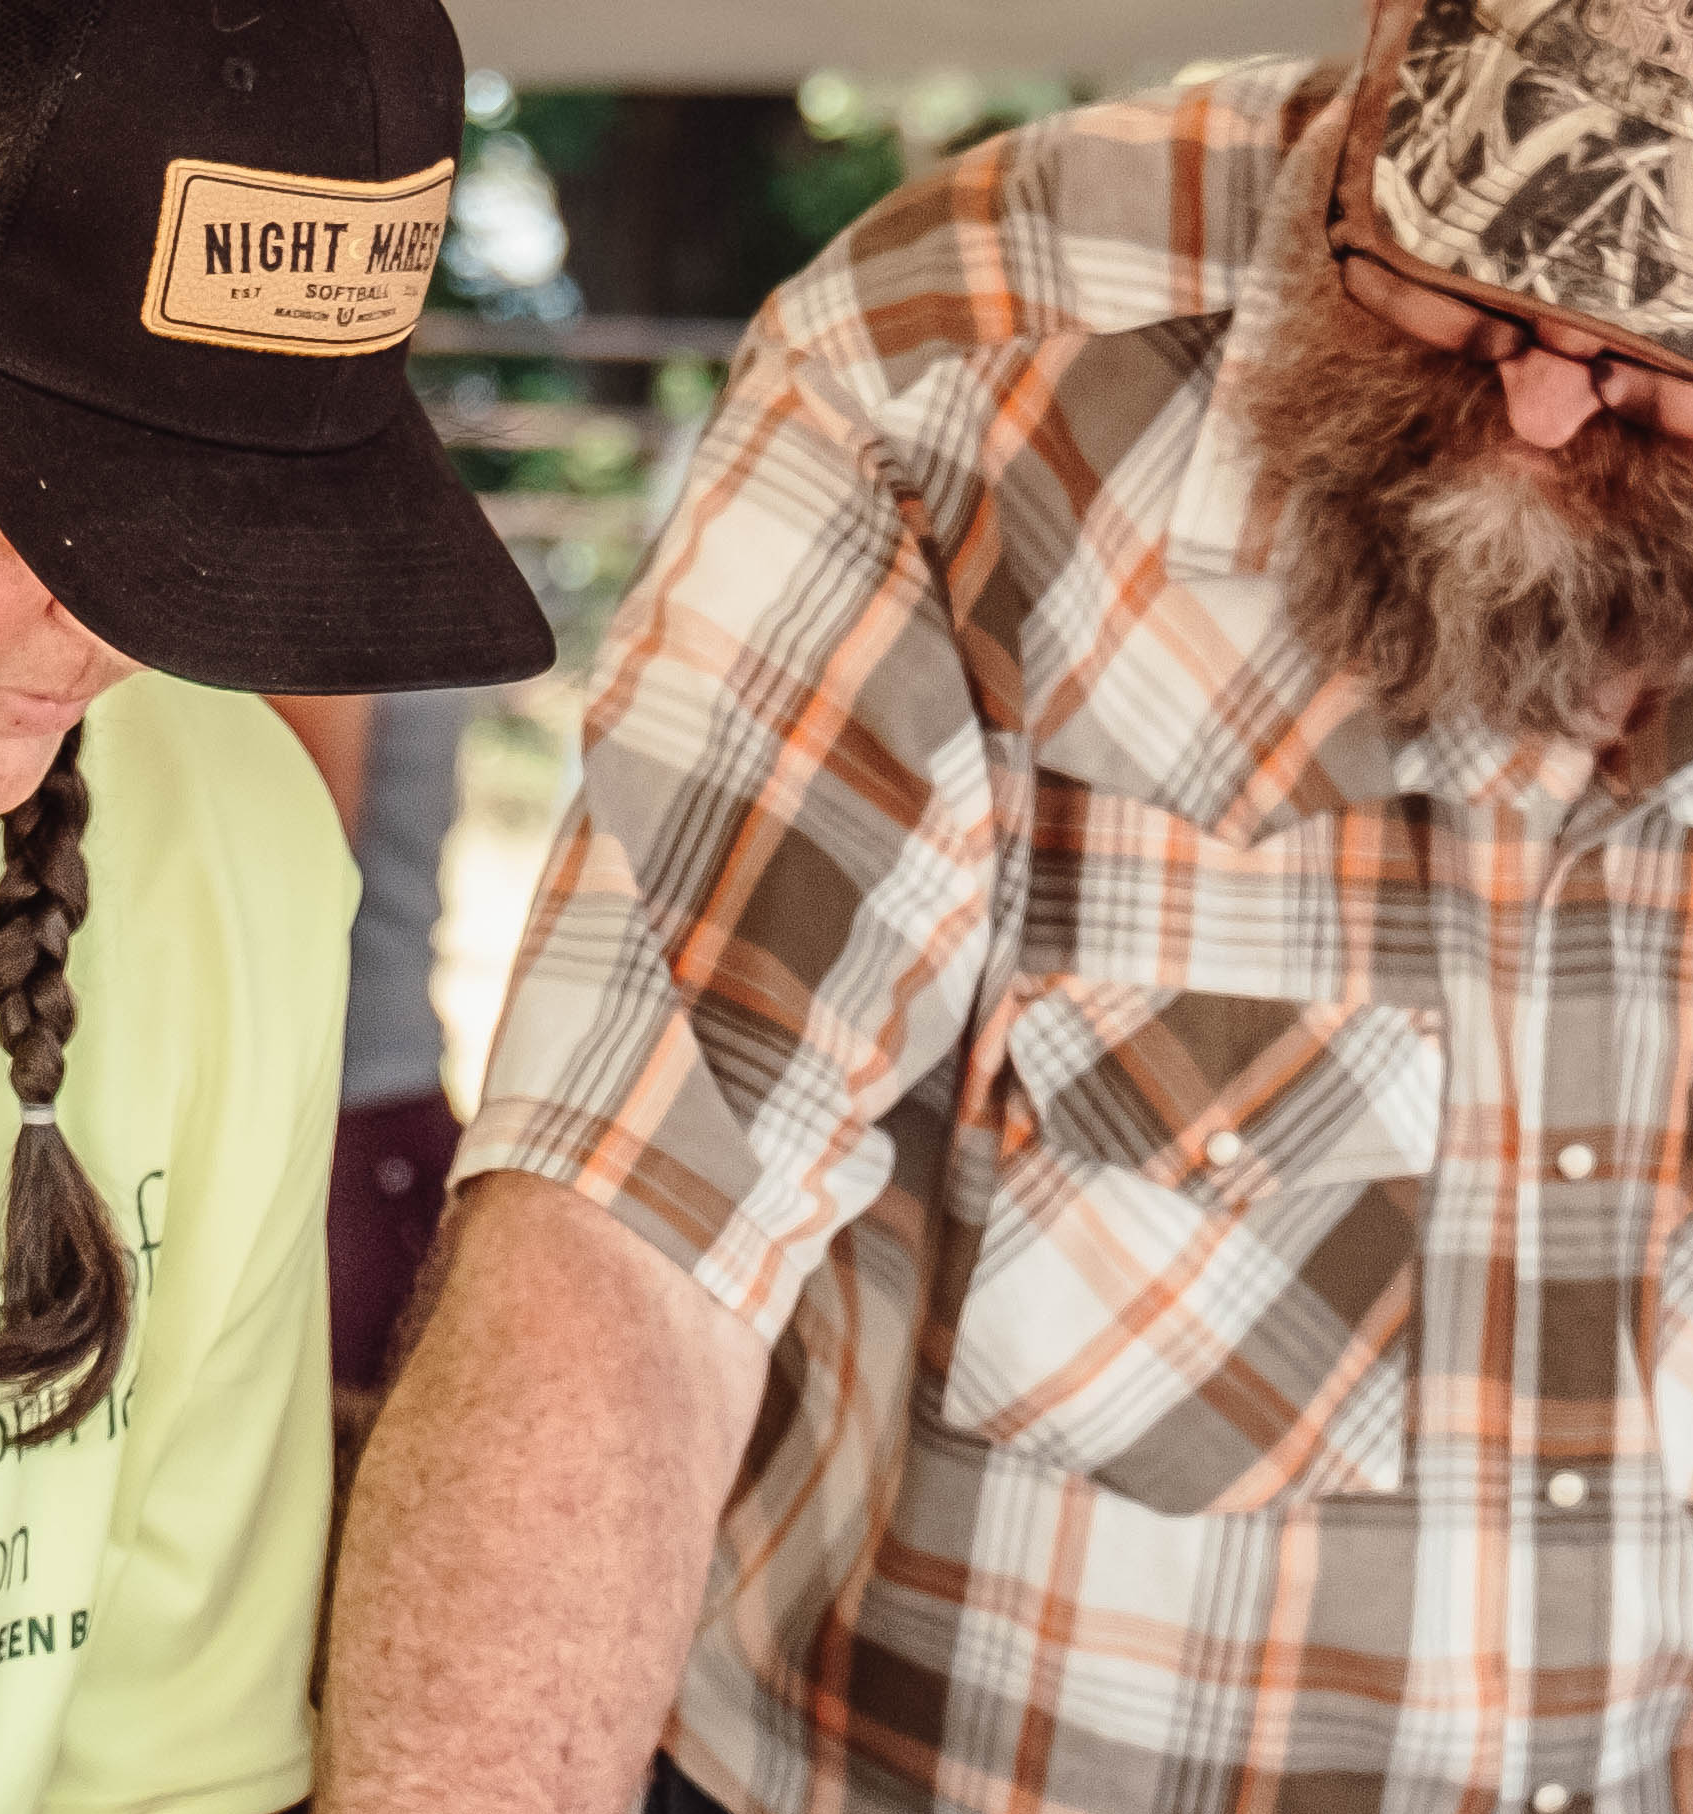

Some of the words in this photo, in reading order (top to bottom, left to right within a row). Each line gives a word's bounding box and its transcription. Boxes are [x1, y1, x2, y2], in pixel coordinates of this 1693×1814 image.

[204, 222, 349, 275] NIGHT
[230, 286, 262, 300] EST
[305, 283, 390, 302] SOFTBALL
